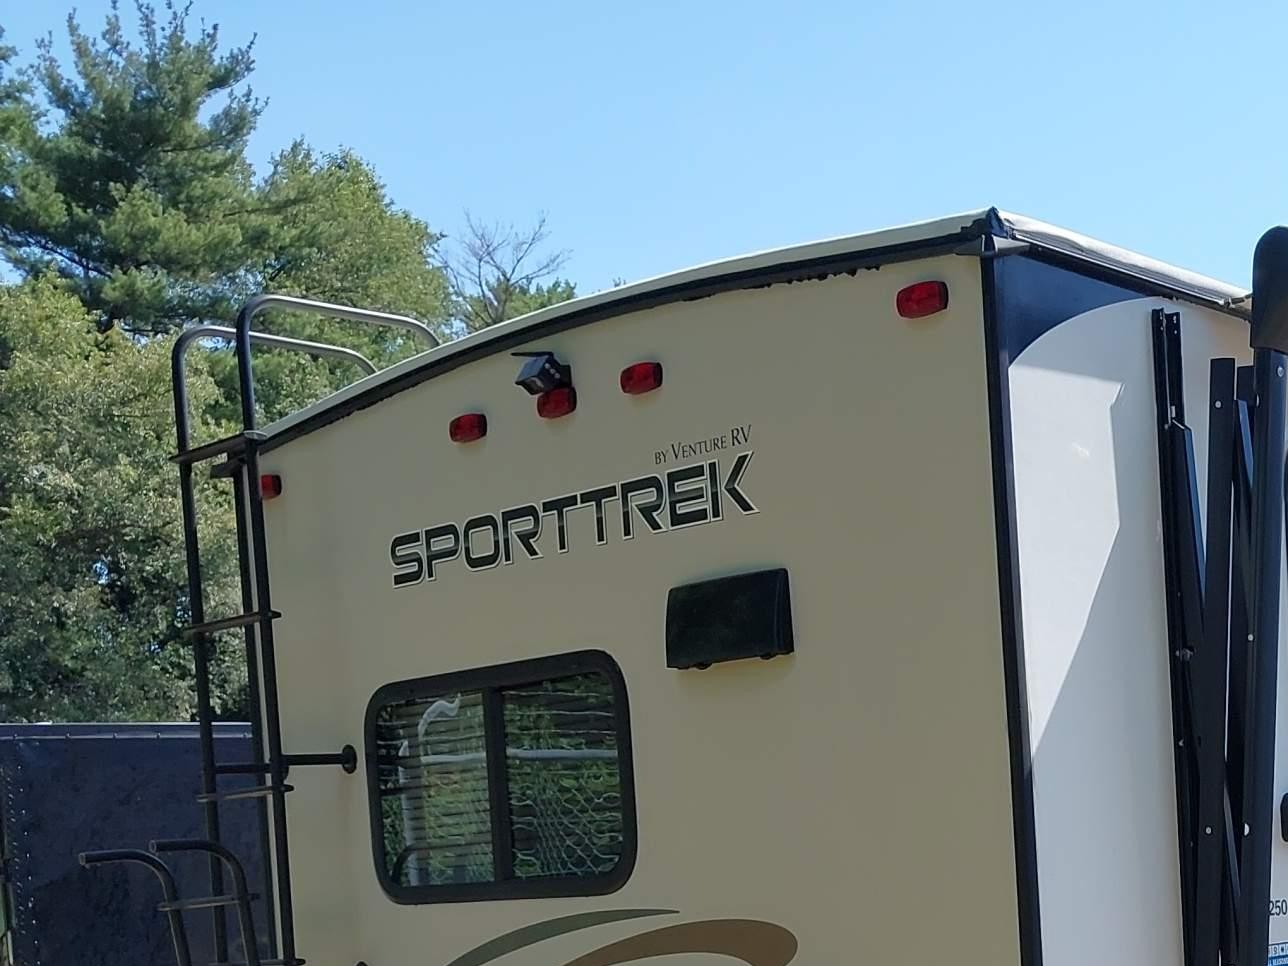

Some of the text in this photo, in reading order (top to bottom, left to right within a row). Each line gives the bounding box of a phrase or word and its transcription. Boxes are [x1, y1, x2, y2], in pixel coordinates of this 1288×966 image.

[654, 424, 752, 465] BY VENTURE RV
[389, 449, 761, 588] SPORTTREK
[1269, 899, 1288, 916] 250
